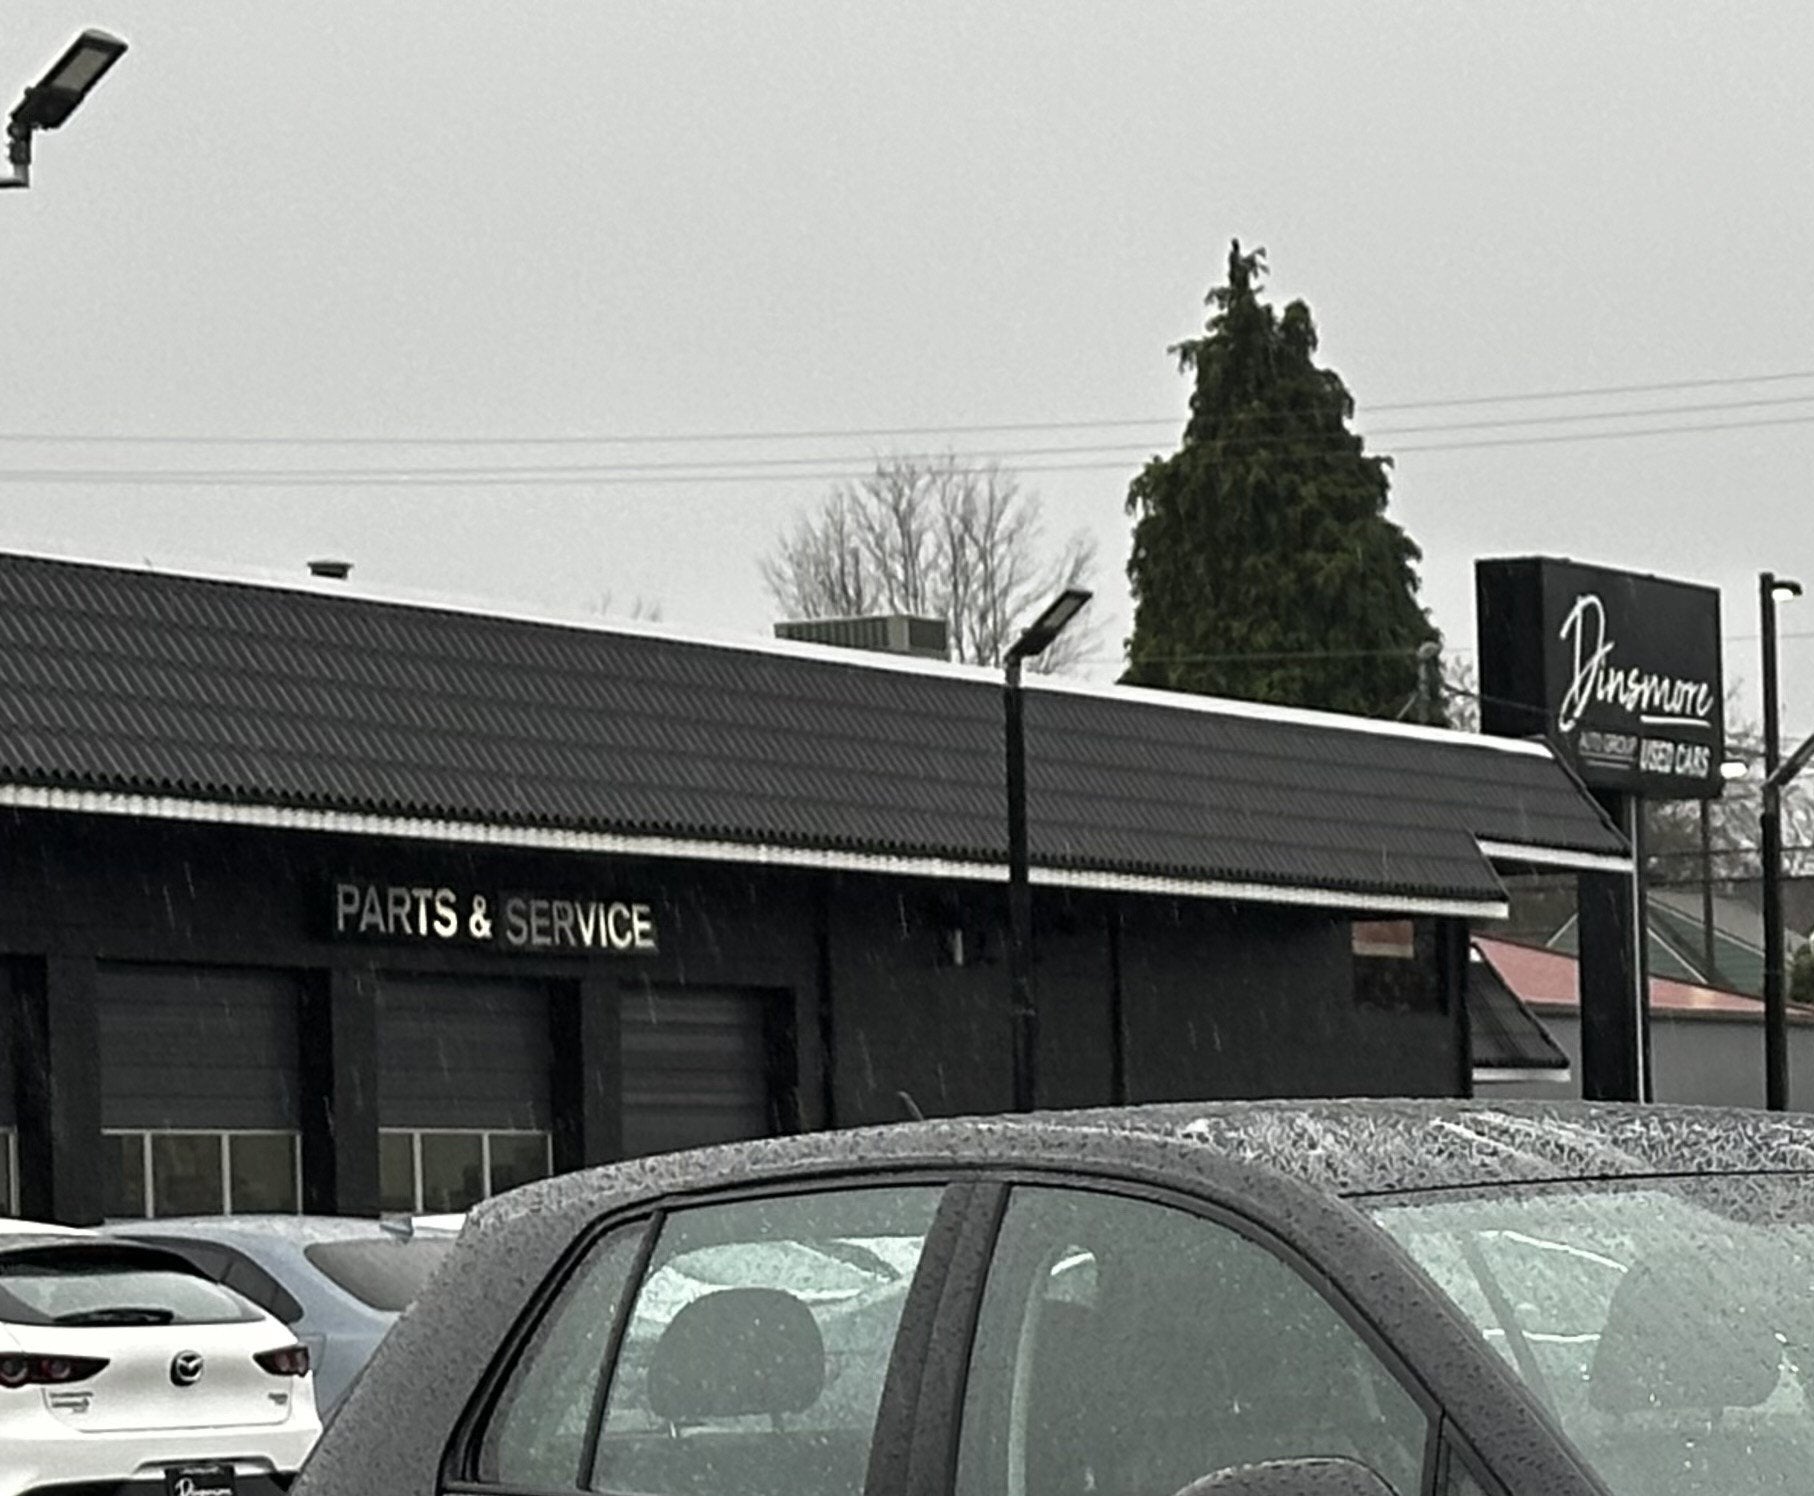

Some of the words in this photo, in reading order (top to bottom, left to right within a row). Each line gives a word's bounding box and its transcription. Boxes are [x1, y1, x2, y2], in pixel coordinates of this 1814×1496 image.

[1559, 595, 1714, 732] Dinsmore
[337, 884, 458, 938] PARTS
[469, 894, 492, 939] &
[506, 898, 656, 949] SERVICE
